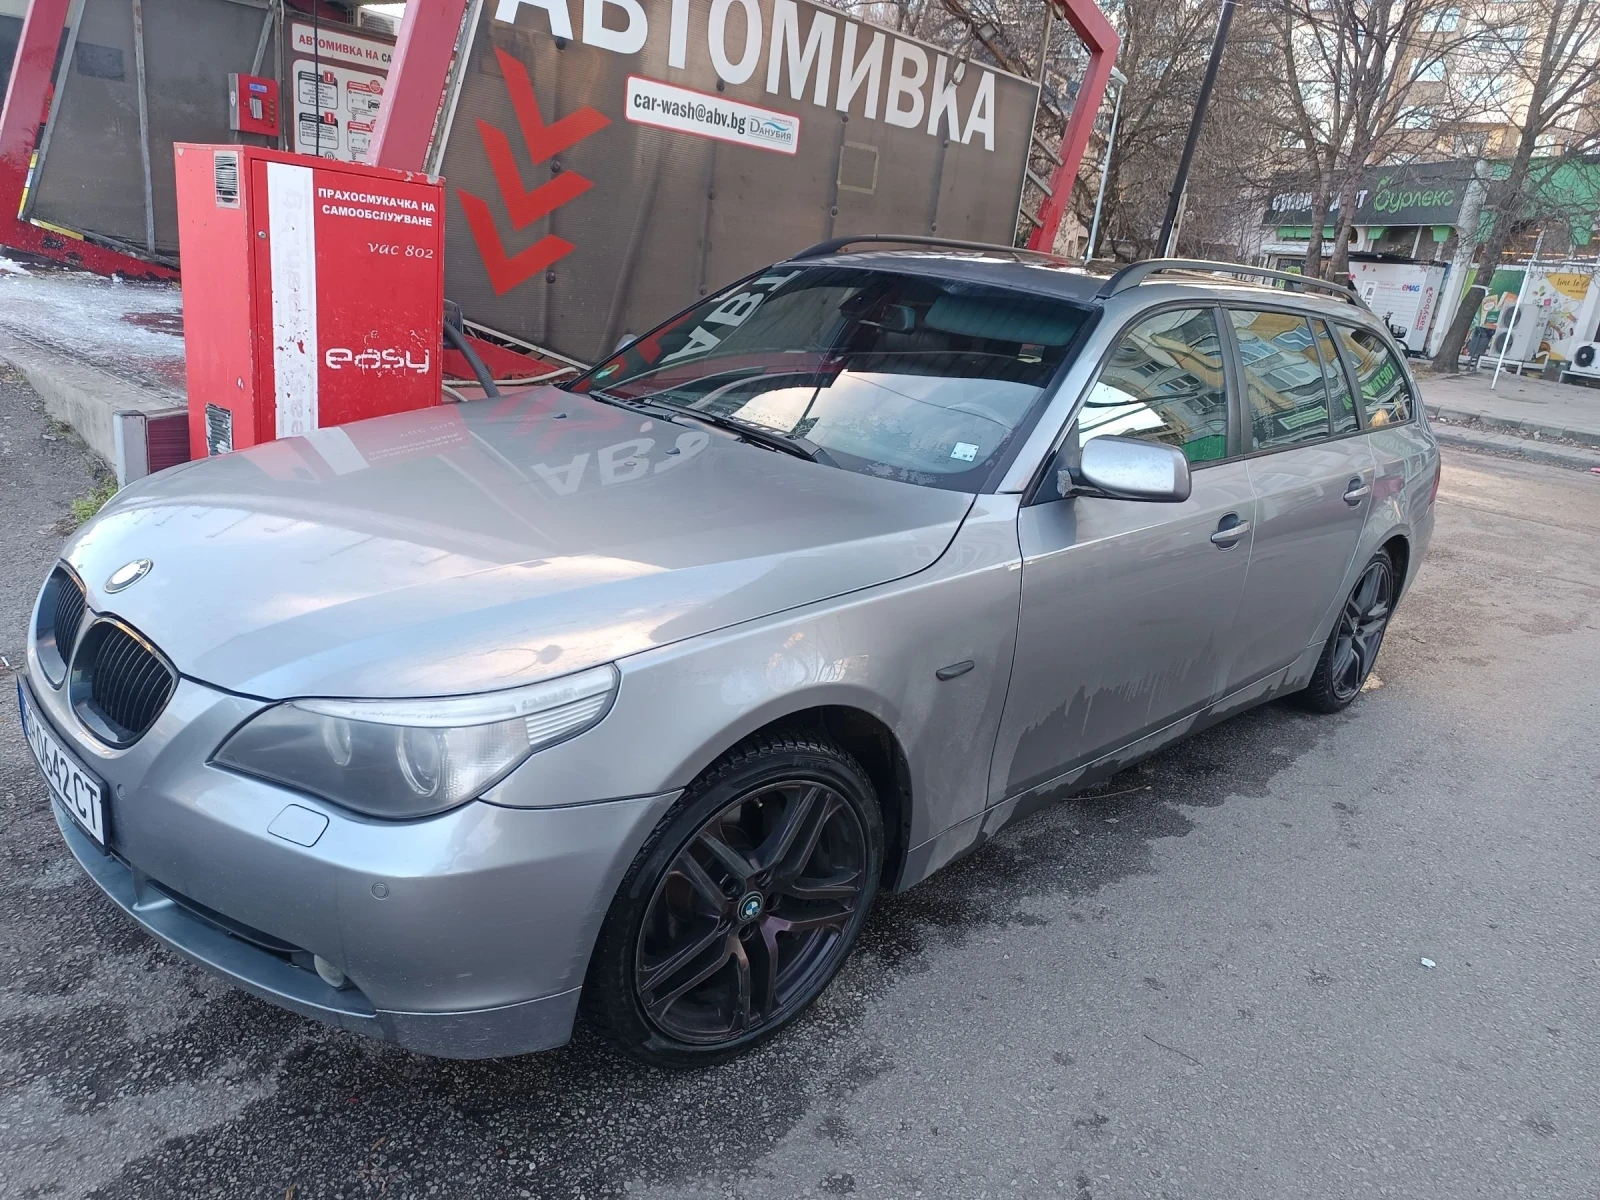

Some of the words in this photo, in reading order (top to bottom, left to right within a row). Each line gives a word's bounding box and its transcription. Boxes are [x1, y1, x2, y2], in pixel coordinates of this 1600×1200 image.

[298, 34, 363, 57] АВОМИВКА
[365, 49, 379, 61] НА
[633, 93, 747, 135] car-wash@abv.bg
[318, 187, 419, 210] ПРАХОСМУКАЧКА
[421, 202, 436, 213] НА
[322, 204, 433, 227] САМООБСЛУЖВАНЕ
[367, 242, 400, 256] vac
[404, 244, 434, 259] 802
[325, 348, 430, 374] easy
